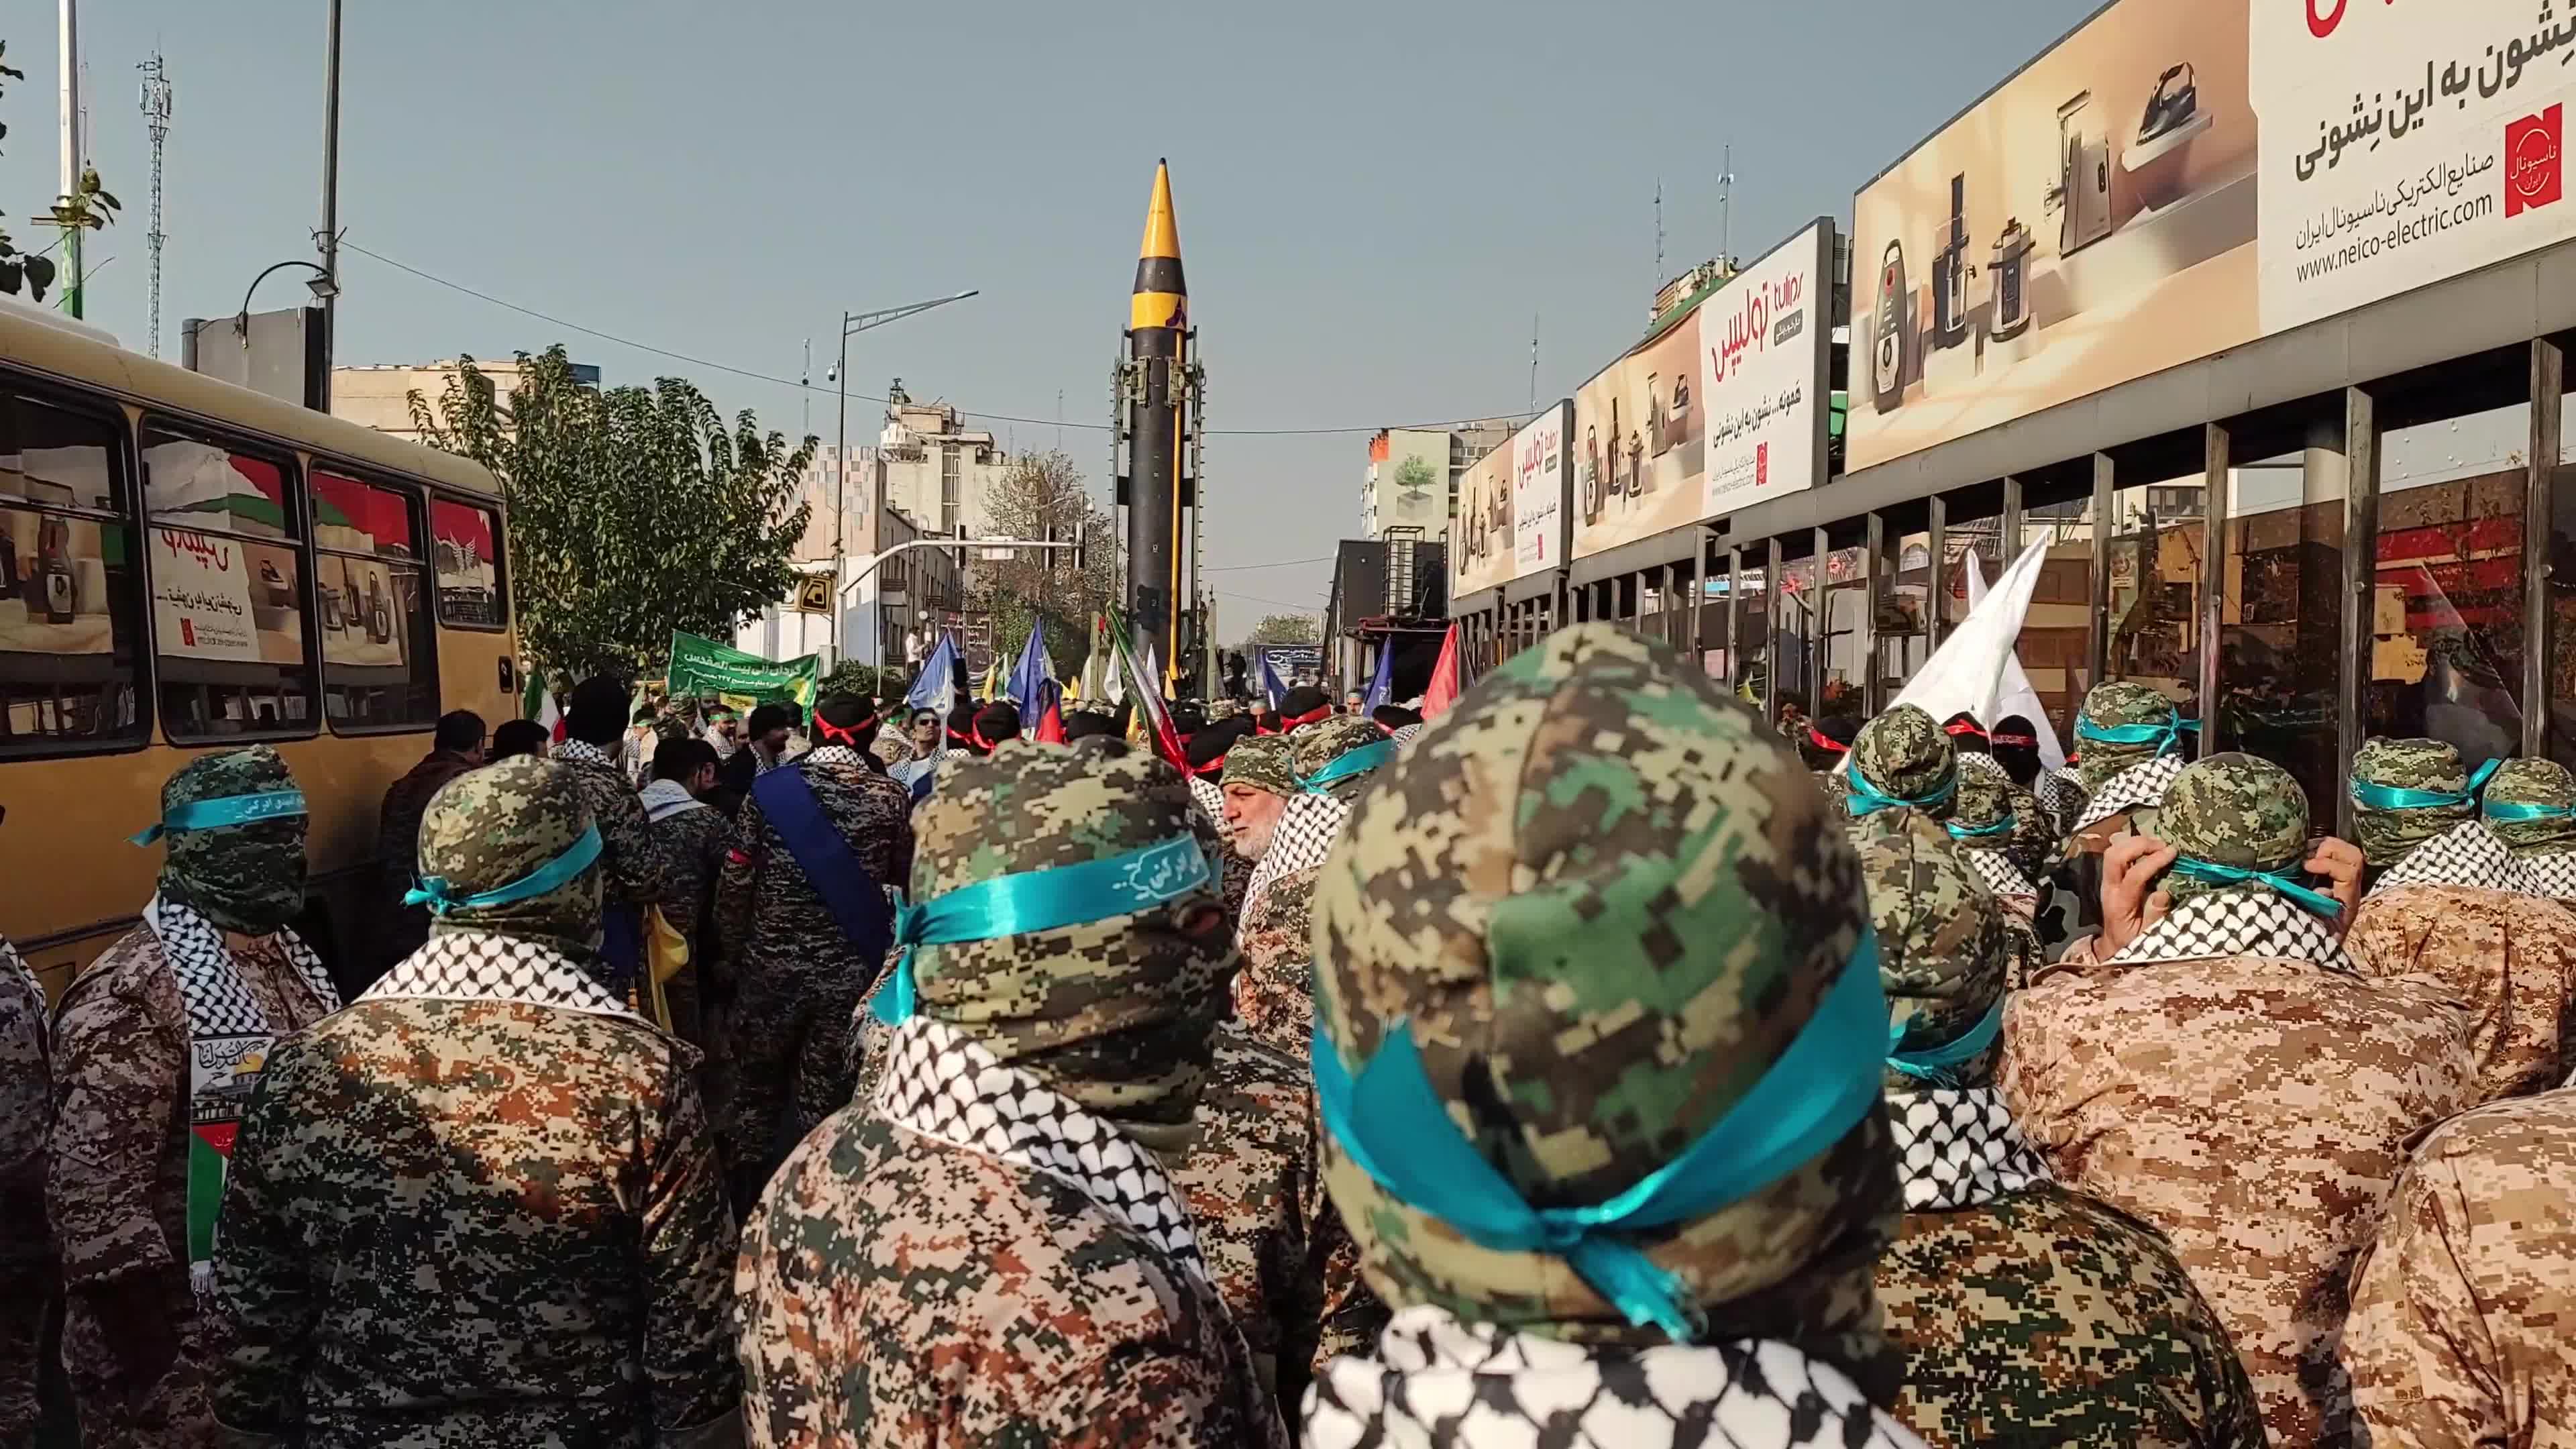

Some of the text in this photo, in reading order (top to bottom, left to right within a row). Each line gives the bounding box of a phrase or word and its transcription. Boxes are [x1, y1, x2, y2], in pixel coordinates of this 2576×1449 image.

[2389, 60, 2434, 140] این
[2440, 60, 2471, 110] به
[2510, 144, 2557, 180] ناسیونال
[2296, 152, 2494, 250] صنایع الکتریکی ناسیونال ایران
[2296, 193, 2492, 283] www.neico-electric.com
[1774, 270, 1804, 312] tulips
[1711, 280, 1768, 382] تولیپس
[1734, 407, 1743, 439] این
[1745, 411, 1751, 434] به
[684, 653, 729, 670] المقدس
